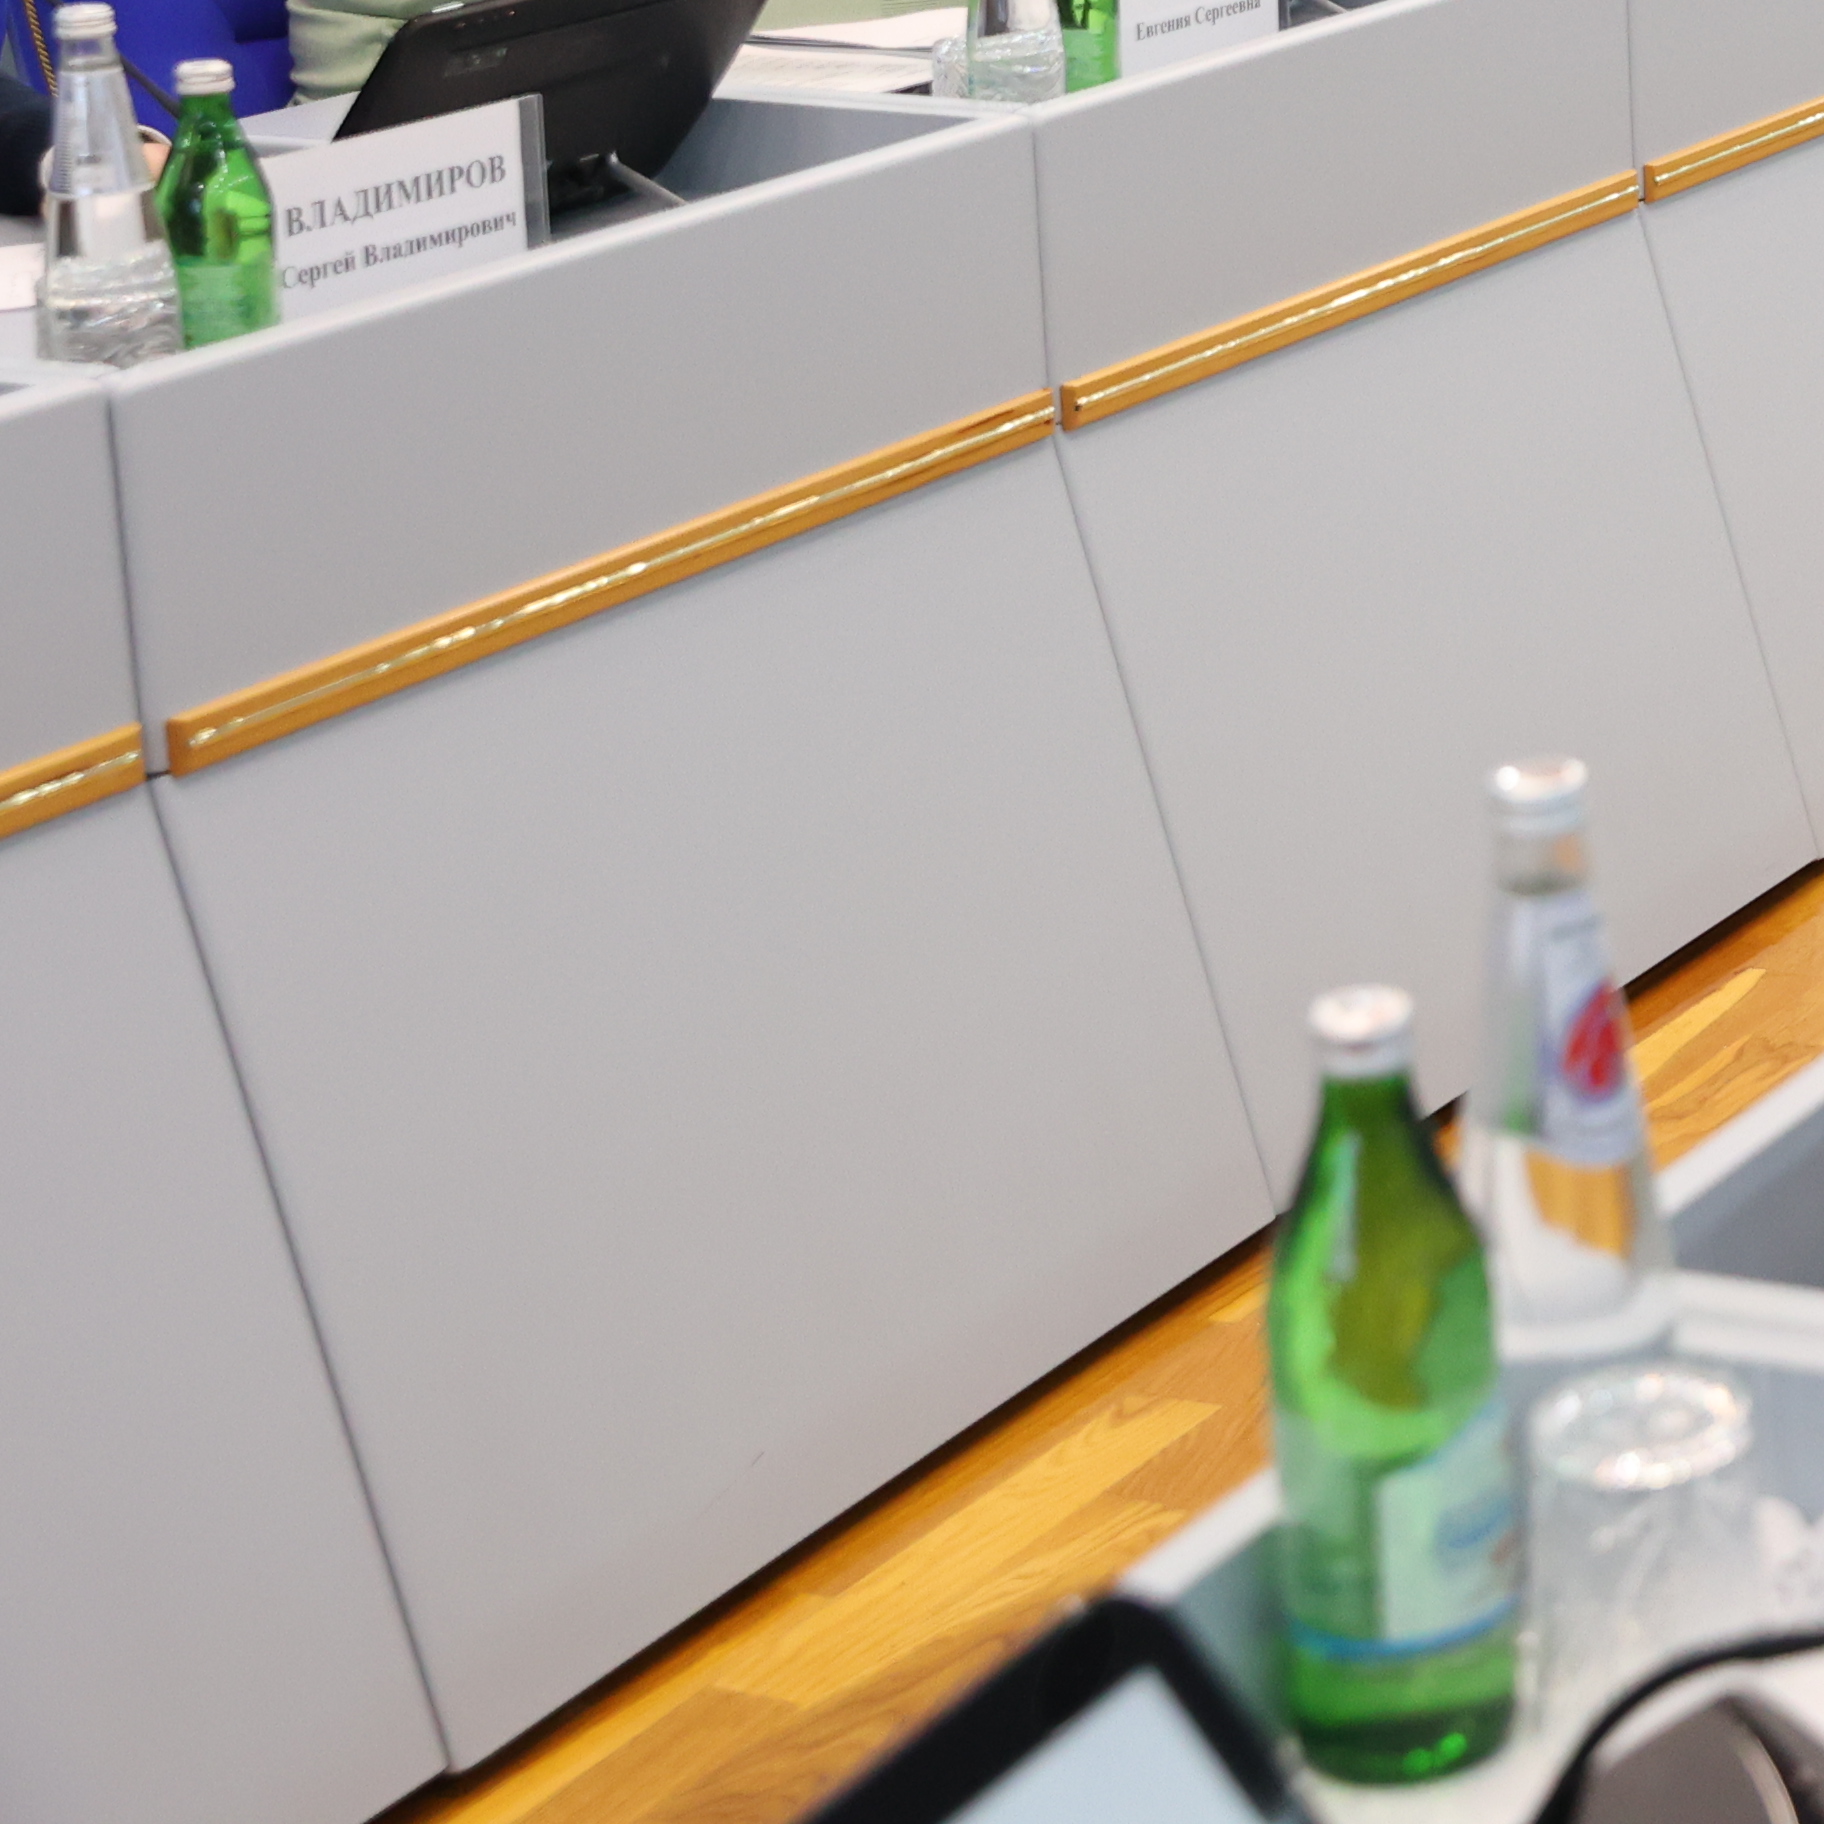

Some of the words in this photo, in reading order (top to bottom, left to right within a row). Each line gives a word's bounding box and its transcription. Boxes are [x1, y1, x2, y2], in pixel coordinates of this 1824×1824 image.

[1136, 13, 1191, 42] Евгения
[285, 154, 506, 237] ВЛАДИМИРОВ
[281, 250, 356, 290] Сергей
[363, 211, 517, 268] Владимирович
